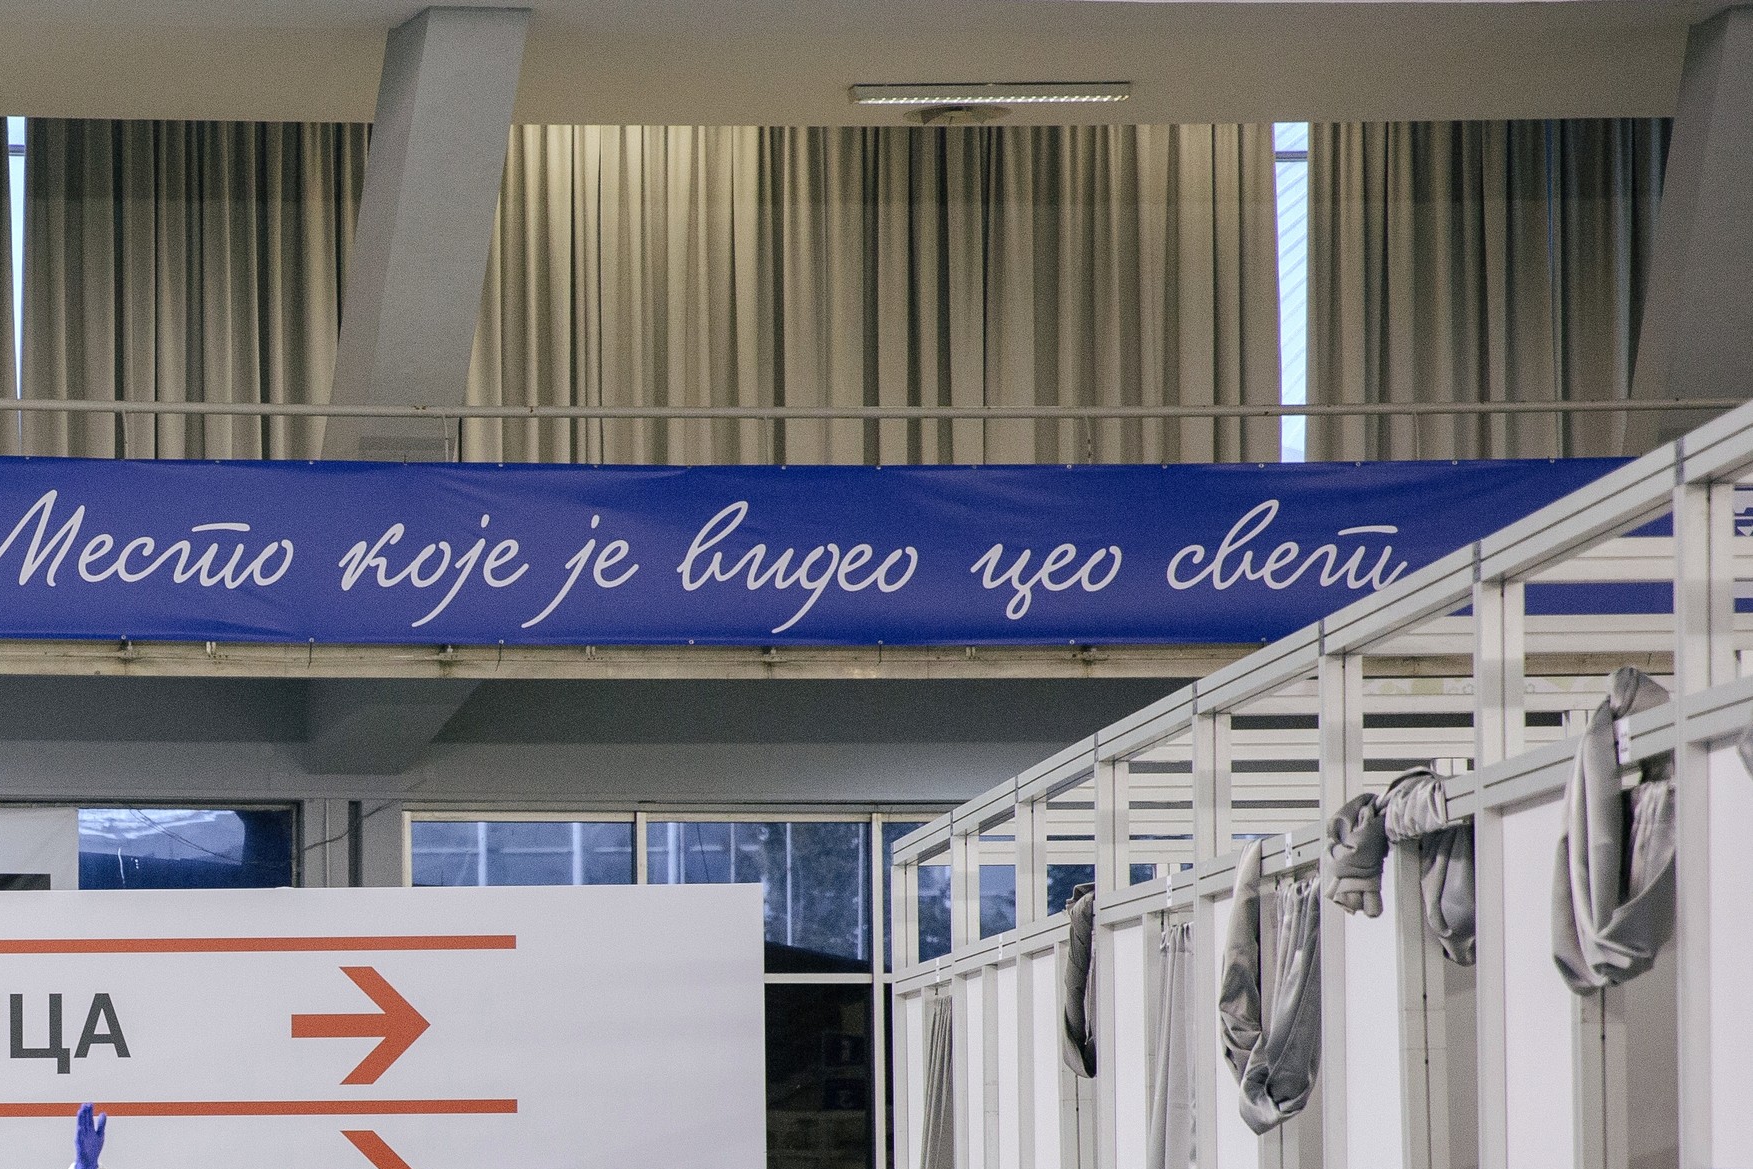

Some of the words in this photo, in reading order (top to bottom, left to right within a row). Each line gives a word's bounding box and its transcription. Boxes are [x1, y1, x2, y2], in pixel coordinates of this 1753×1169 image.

[338, 514, 530, 629] које
[519, 514, 640, 629] је
[676, 501, 918, 634] видео
[970, 543, 1122, 621] цео
[1166, 499, 1408, 592] свет
